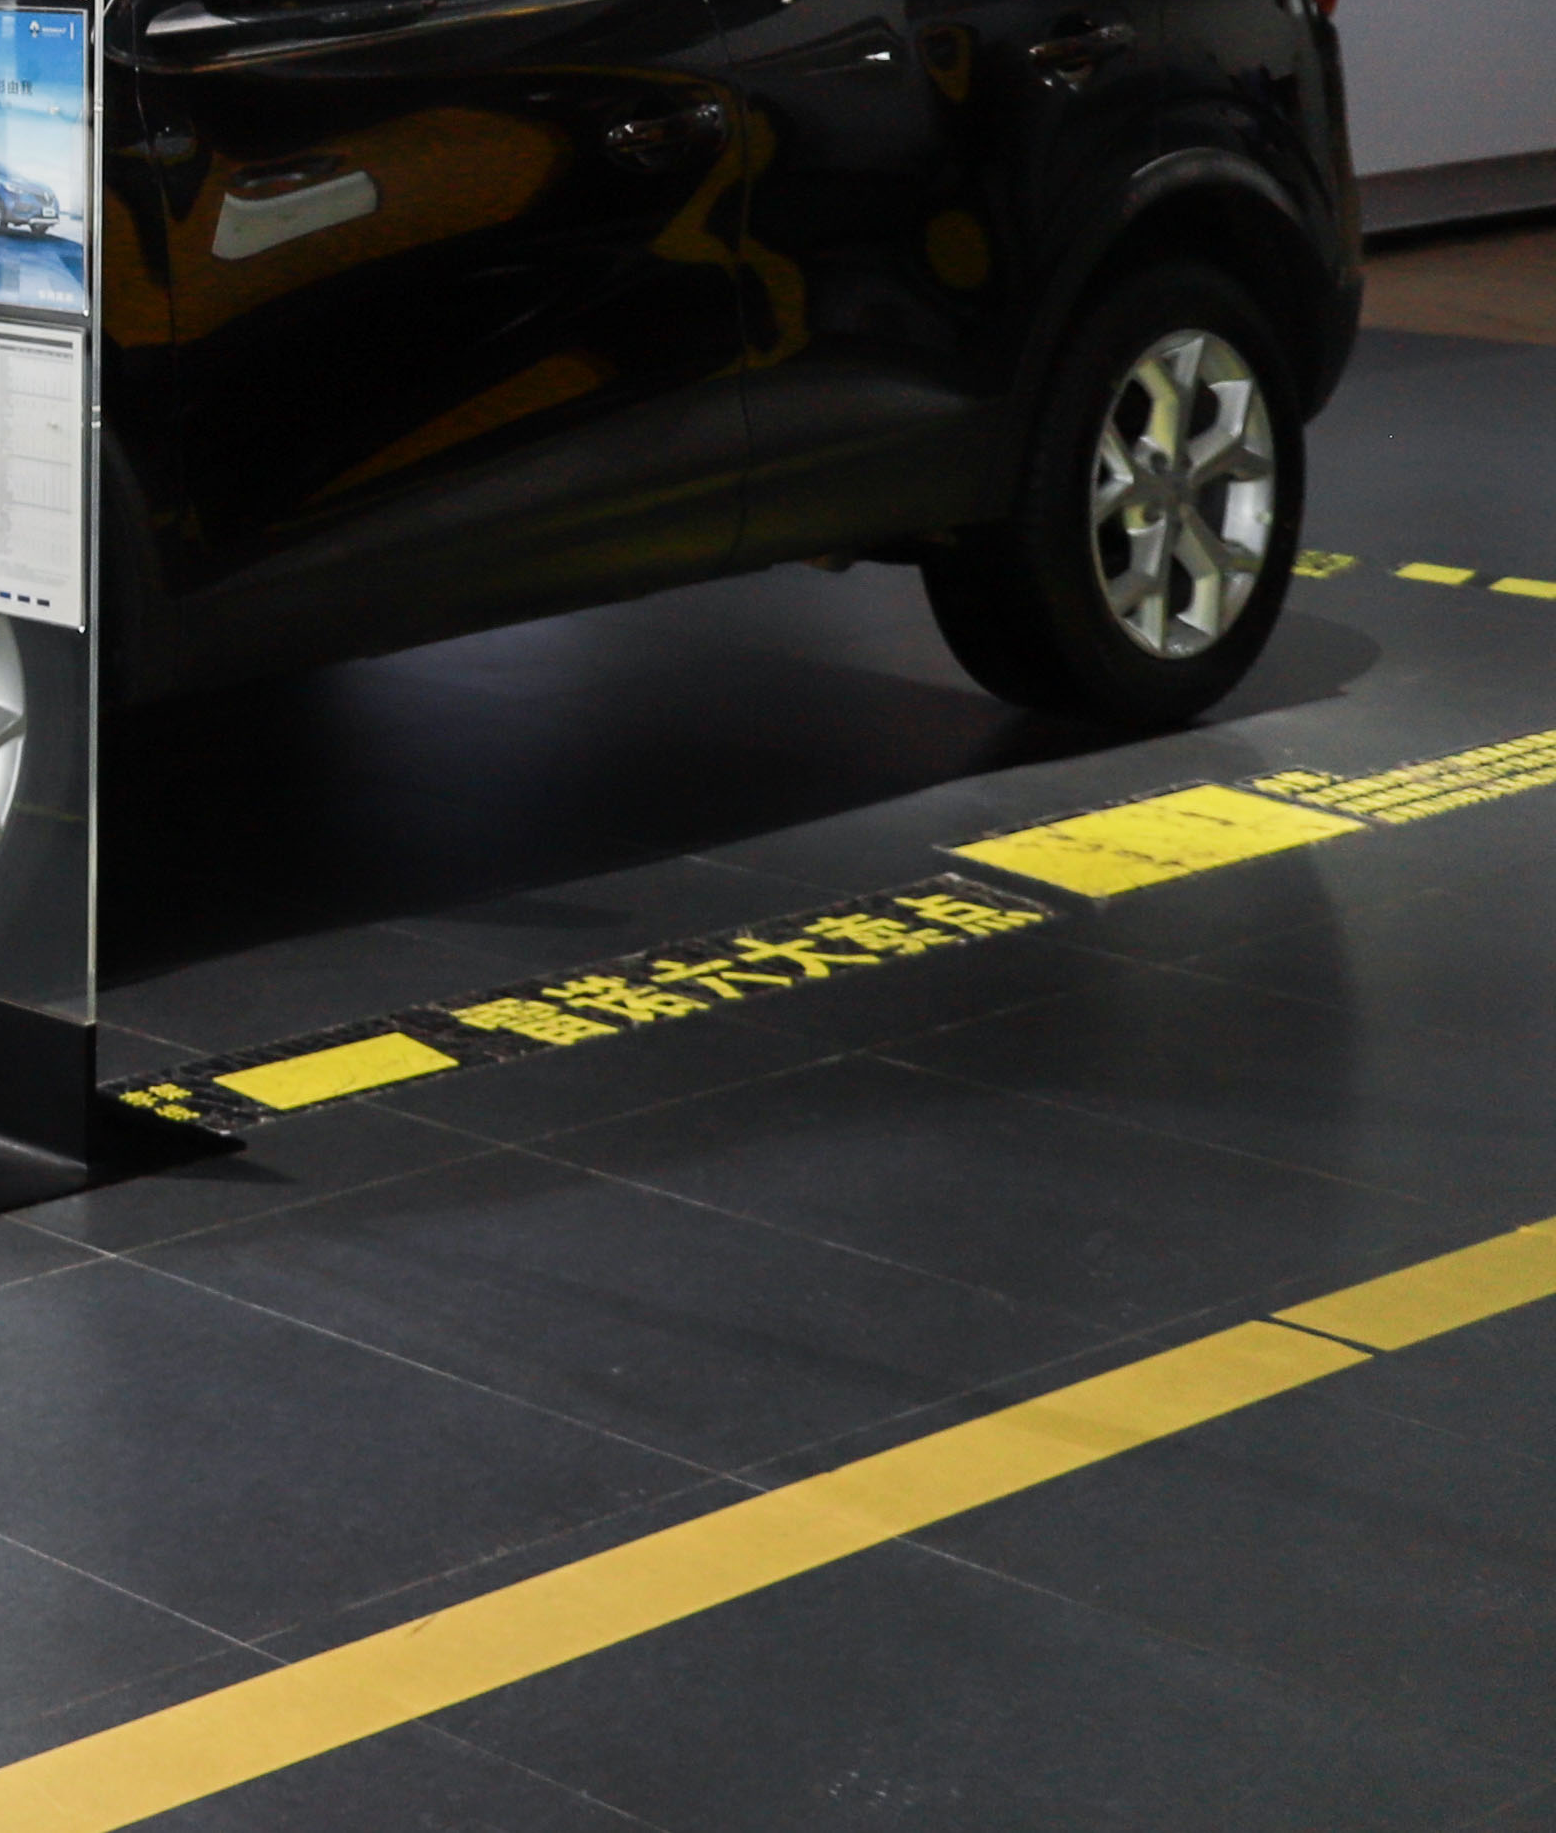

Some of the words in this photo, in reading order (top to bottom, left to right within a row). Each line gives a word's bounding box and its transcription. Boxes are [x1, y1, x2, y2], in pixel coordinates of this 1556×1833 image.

[450, 893, 1044, 1045] 雷诺六大卖点
